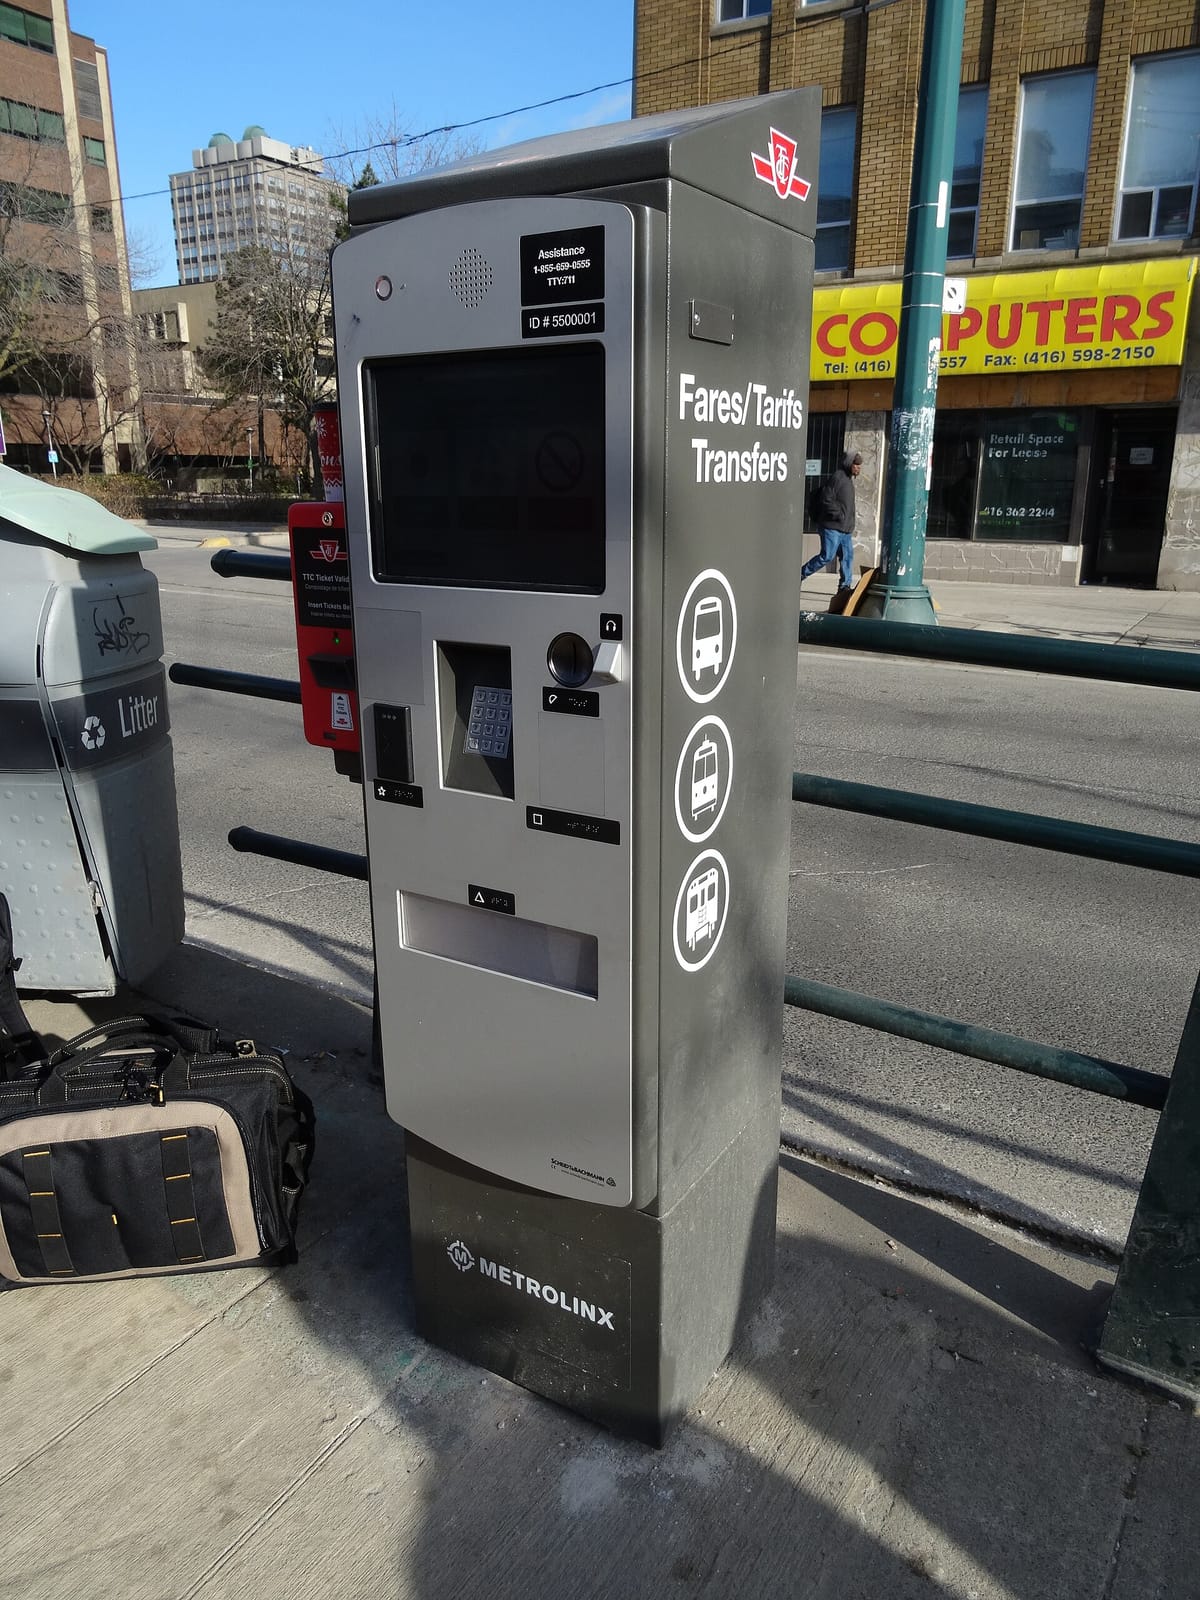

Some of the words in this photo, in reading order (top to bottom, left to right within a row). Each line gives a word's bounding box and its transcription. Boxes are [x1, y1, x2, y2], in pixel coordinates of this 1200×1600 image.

[538, 246, 585, 260] Assistance
[533, 259, 591, 274] 1-855-659-0555
[547, 275, 576, 287] TTY:711
[529, 317, 540, 329] ID
[542, 316, 550, 328] #
[552, 312, 596, 327] 5500001
[816, 291, 1176, 357] COPUTERS
[824, 362, 849, 374] Tel:
[854, 360, 891, 373] (416)
[984, 354, 1017, 366] Fax:
[1023, 350, 1066, 365] (416)
[1072, 345, 1155, 362] 598-2150
[990, 433, 1024, 444] Retail
[1028, 433, 1064, 446] Space
[691, 438, 788, 483] Transfers
[988, 447, 1009, 458] For
[1012, 447, 1048, 458] Lease
[302, 573, 315, 581] TTC
[316, 574, 334, 582] Ticket
[118, 695, 158, 738] Litter
[479, 1256, 615, 1331] METROLINX
